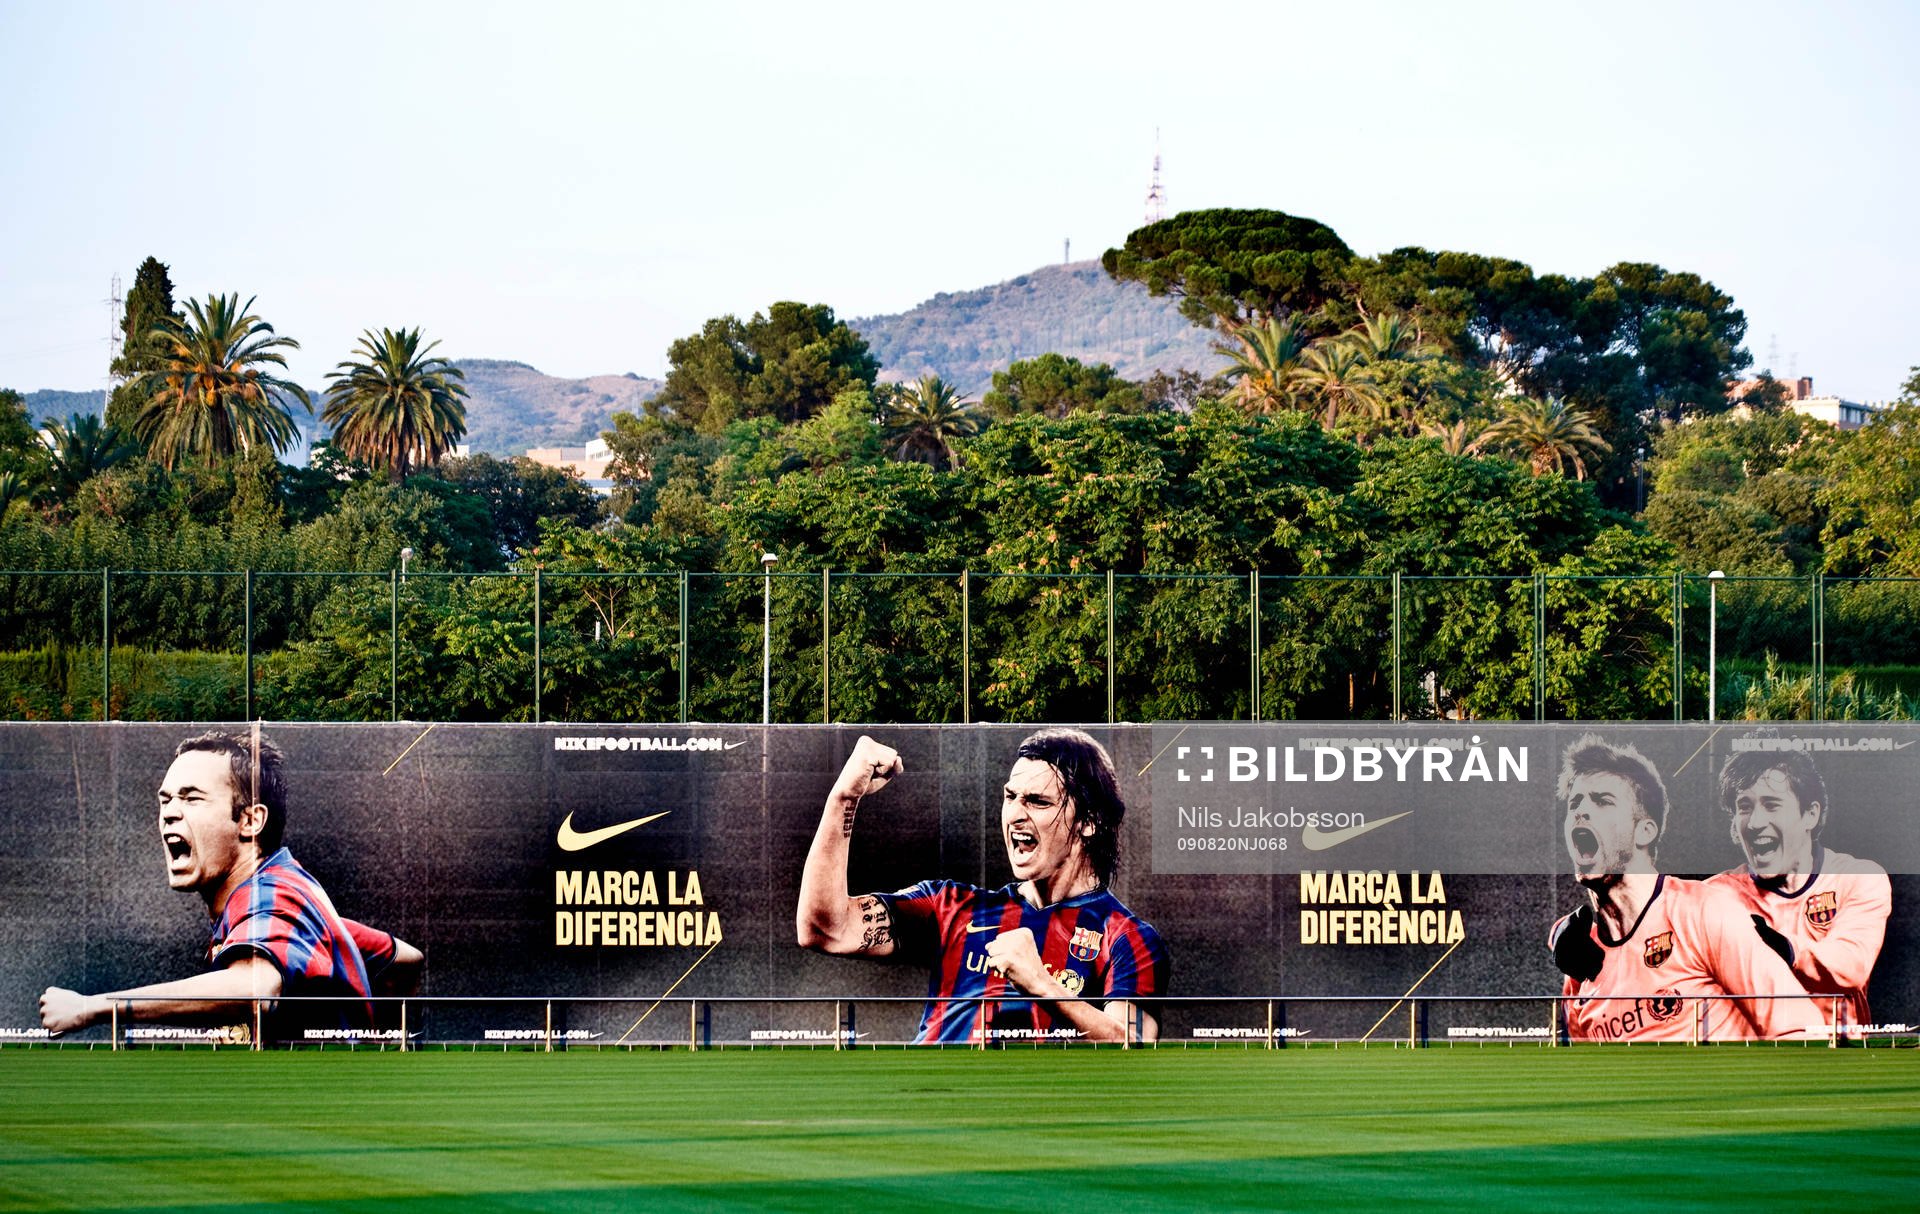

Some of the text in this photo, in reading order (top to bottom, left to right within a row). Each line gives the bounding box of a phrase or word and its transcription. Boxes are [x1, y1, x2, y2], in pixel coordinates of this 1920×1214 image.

[554, 737, 723, 751] NIKEFOOTBALL.COM
[555, 870, 703, 905] MARCA LA
[1300, 869, 1446, 904] MARCA LA
[555, 911, 723, 946] DIFERENCIA
[1300, 903, 1465, 945] DIFERÈNCIA
[1591, 998, 1644, 1042] nicef
